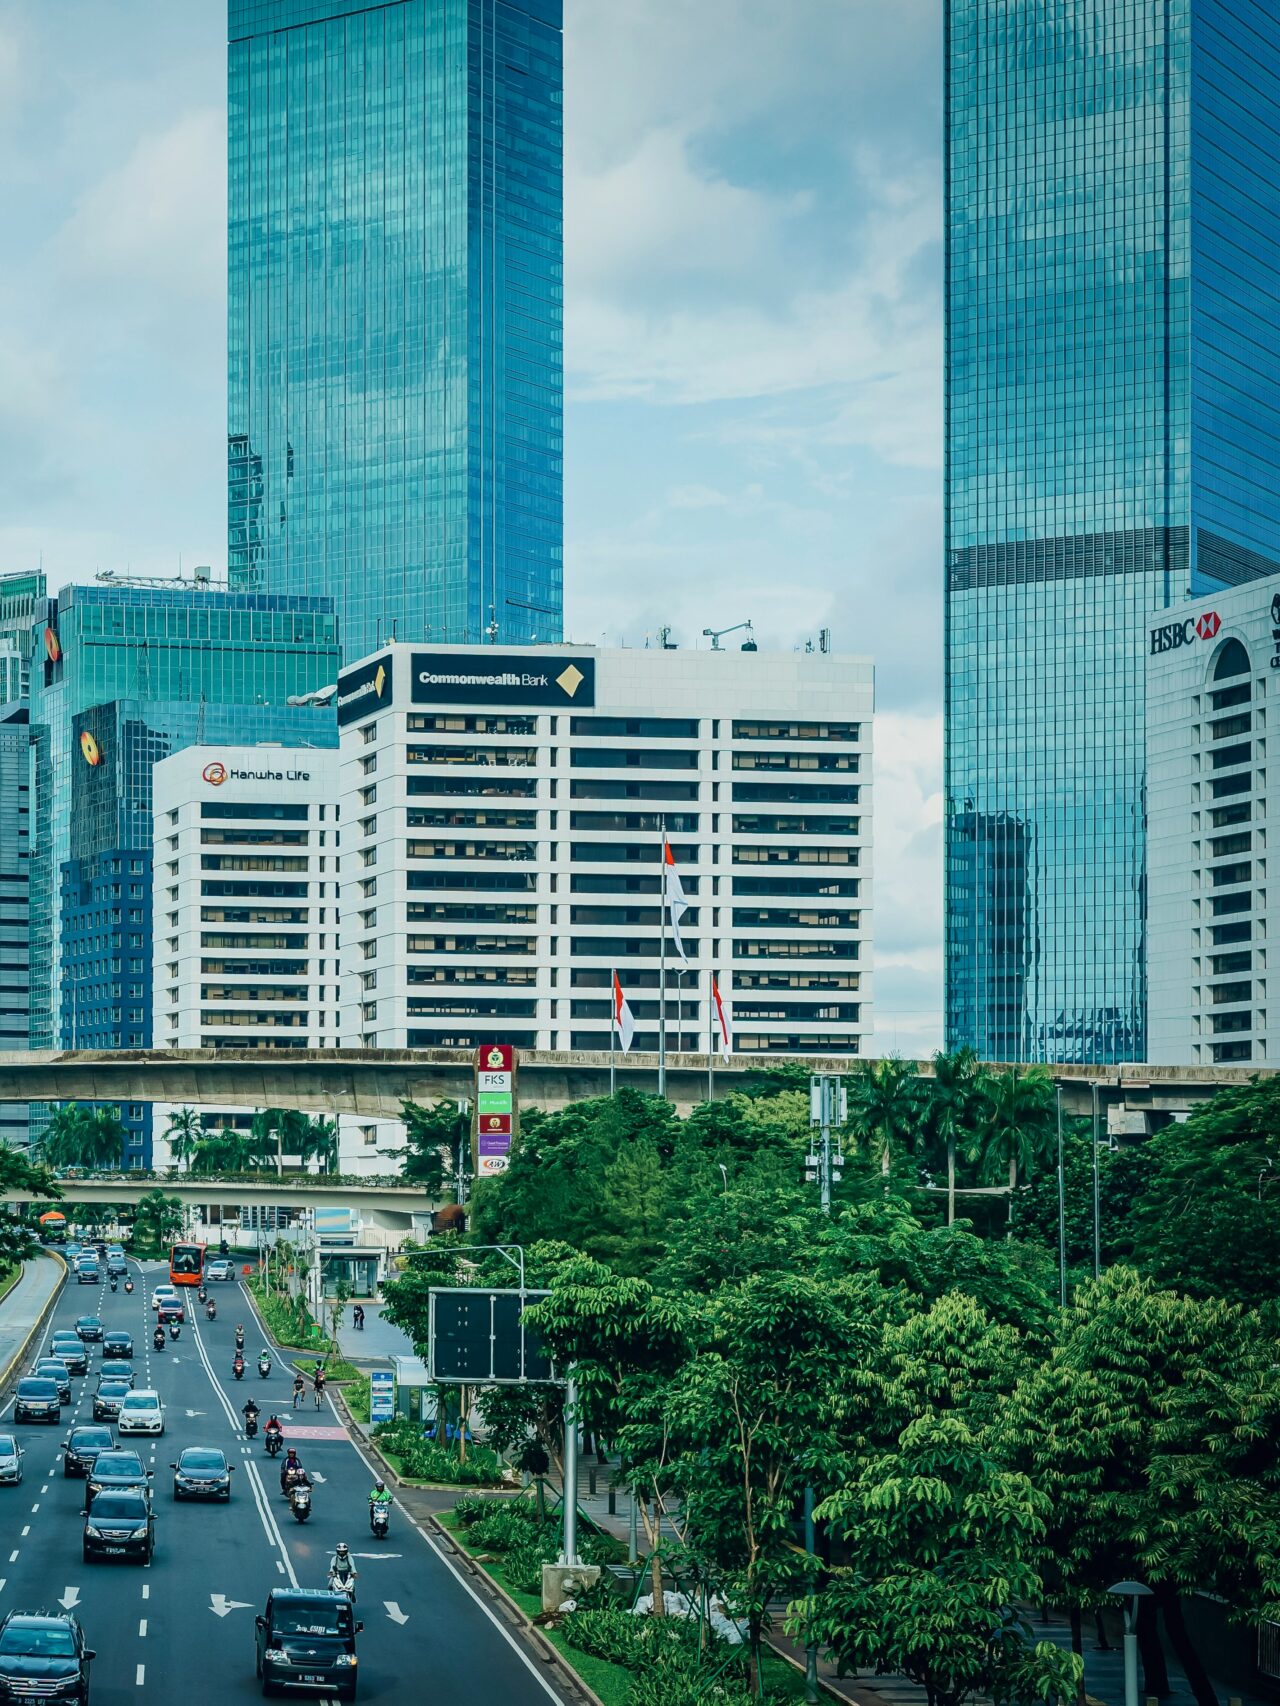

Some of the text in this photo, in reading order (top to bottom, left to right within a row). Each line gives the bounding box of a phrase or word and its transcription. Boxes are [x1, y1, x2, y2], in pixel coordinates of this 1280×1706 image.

[1150, 617, 1195, 655] HSBC
[419, 671, 548, 686] Commonwealth Bank
[230, 769, 310, 781] Hanwha Life
[484, 1075, 505, 1085] FKS
